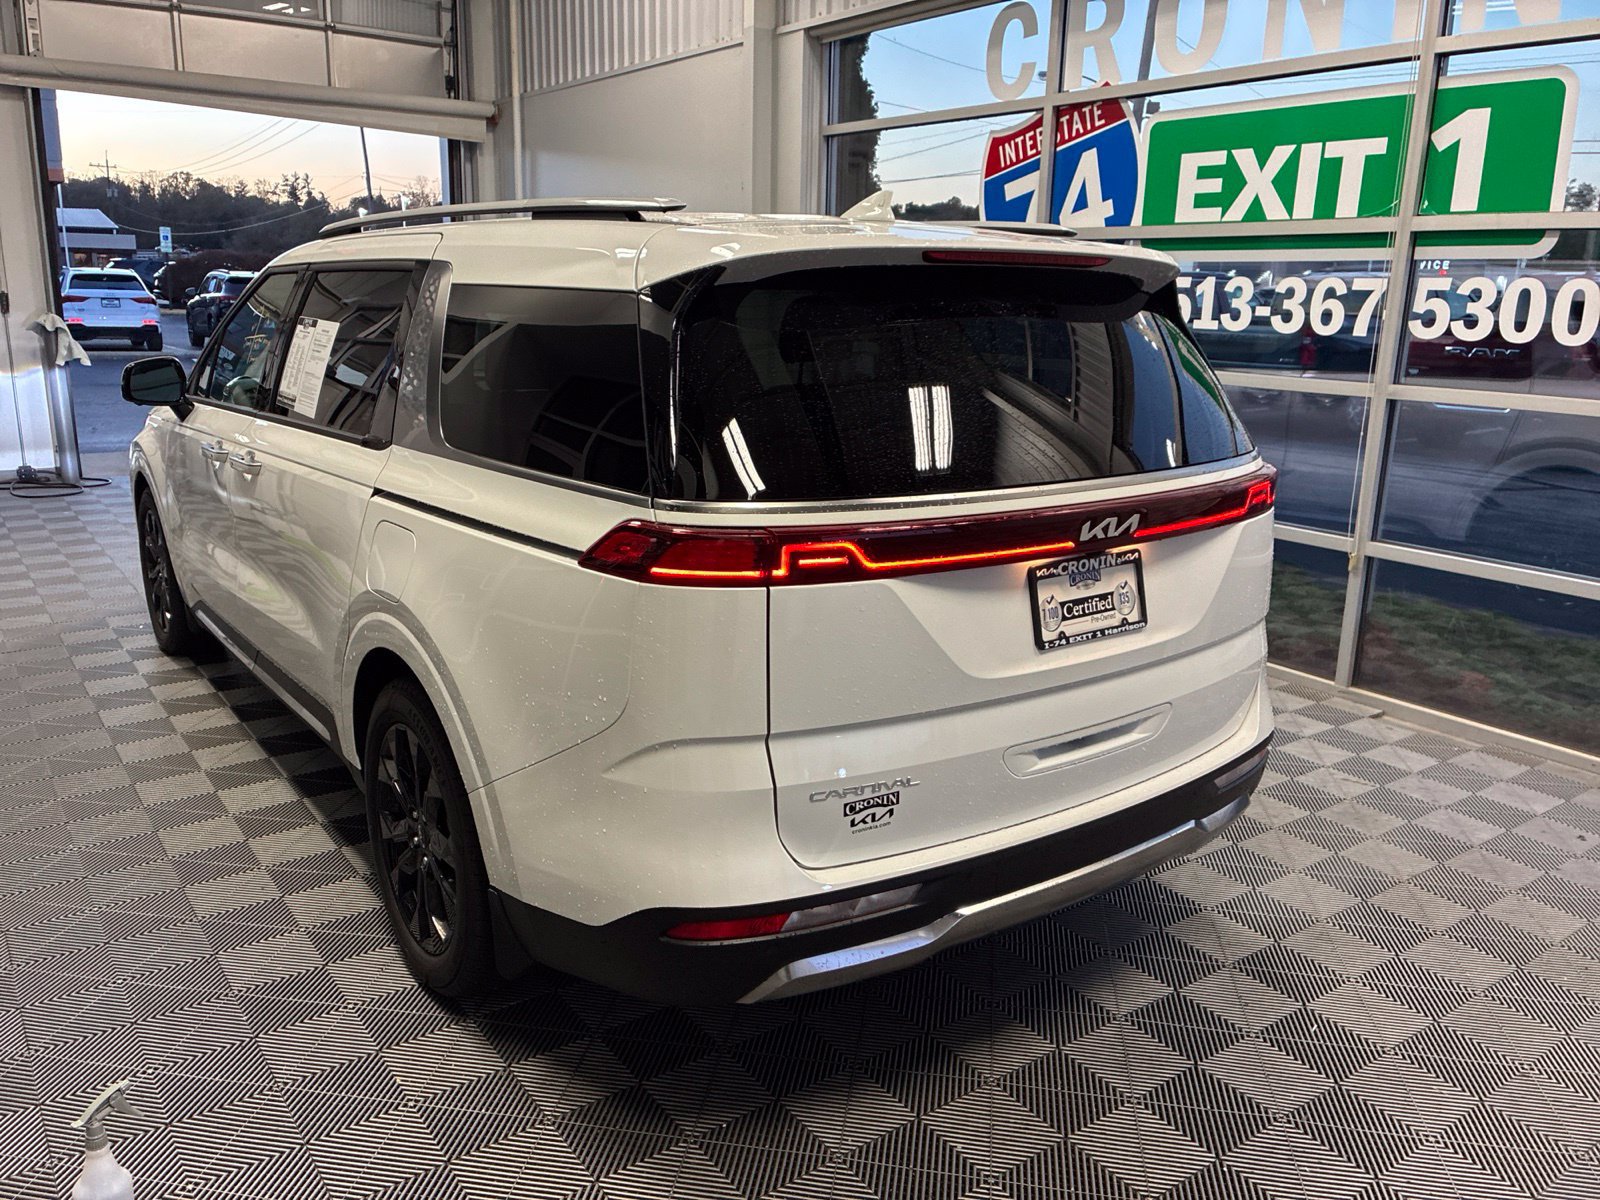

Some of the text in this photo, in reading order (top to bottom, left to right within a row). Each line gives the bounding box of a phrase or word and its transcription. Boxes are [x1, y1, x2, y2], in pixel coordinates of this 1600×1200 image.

[986, 0, 1562, 101] CRON
[999, 102, 1106, 168] INTERTATE
[1175, 107, 1492, 223] EXIT 1
[1004, 147, 1115, 227] 74
[1176, 276, 1600, 347] 513-3675300
[1079, 513, 1141, 542] KIA
[1058, 553, 1117, 576] CRONIN
[1063, 595, 1113, 618] Certified
[1044, 621, 1147, 650] I-74 EXIT 1 Harrison
[845, 792, 898, 816] CRONIN
[850, 807, 894, 828] KIA
